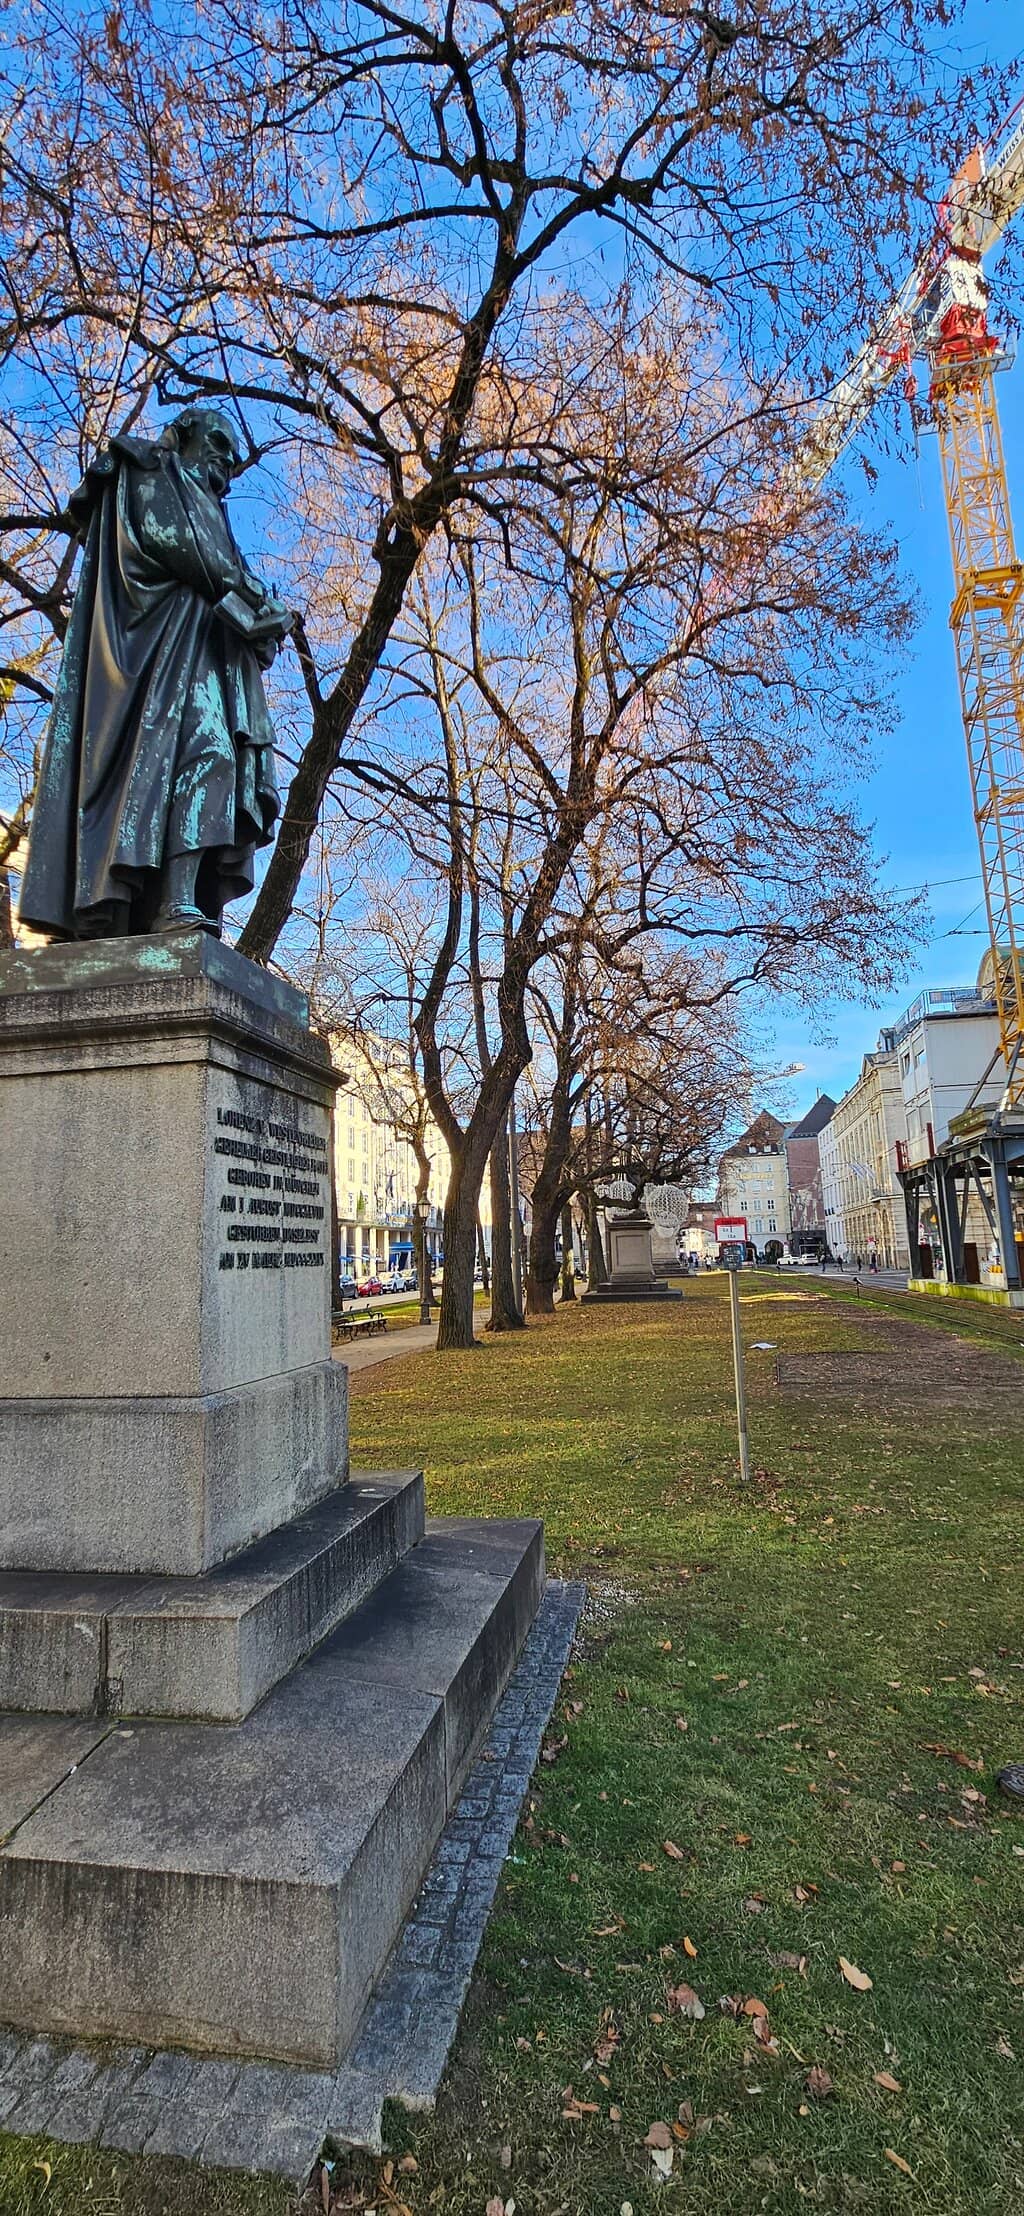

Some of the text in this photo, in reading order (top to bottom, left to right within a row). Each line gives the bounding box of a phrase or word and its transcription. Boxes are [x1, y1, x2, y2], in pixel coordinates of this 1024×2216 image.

[998, 136, 1019, 169] WEISS
[273, 1175, 283, 1190] IN
[220, 1195, 237, 1212] AM
[247, 1198, 282, 1216] AUGUST
[219, 1252, 235, 1270] AM
